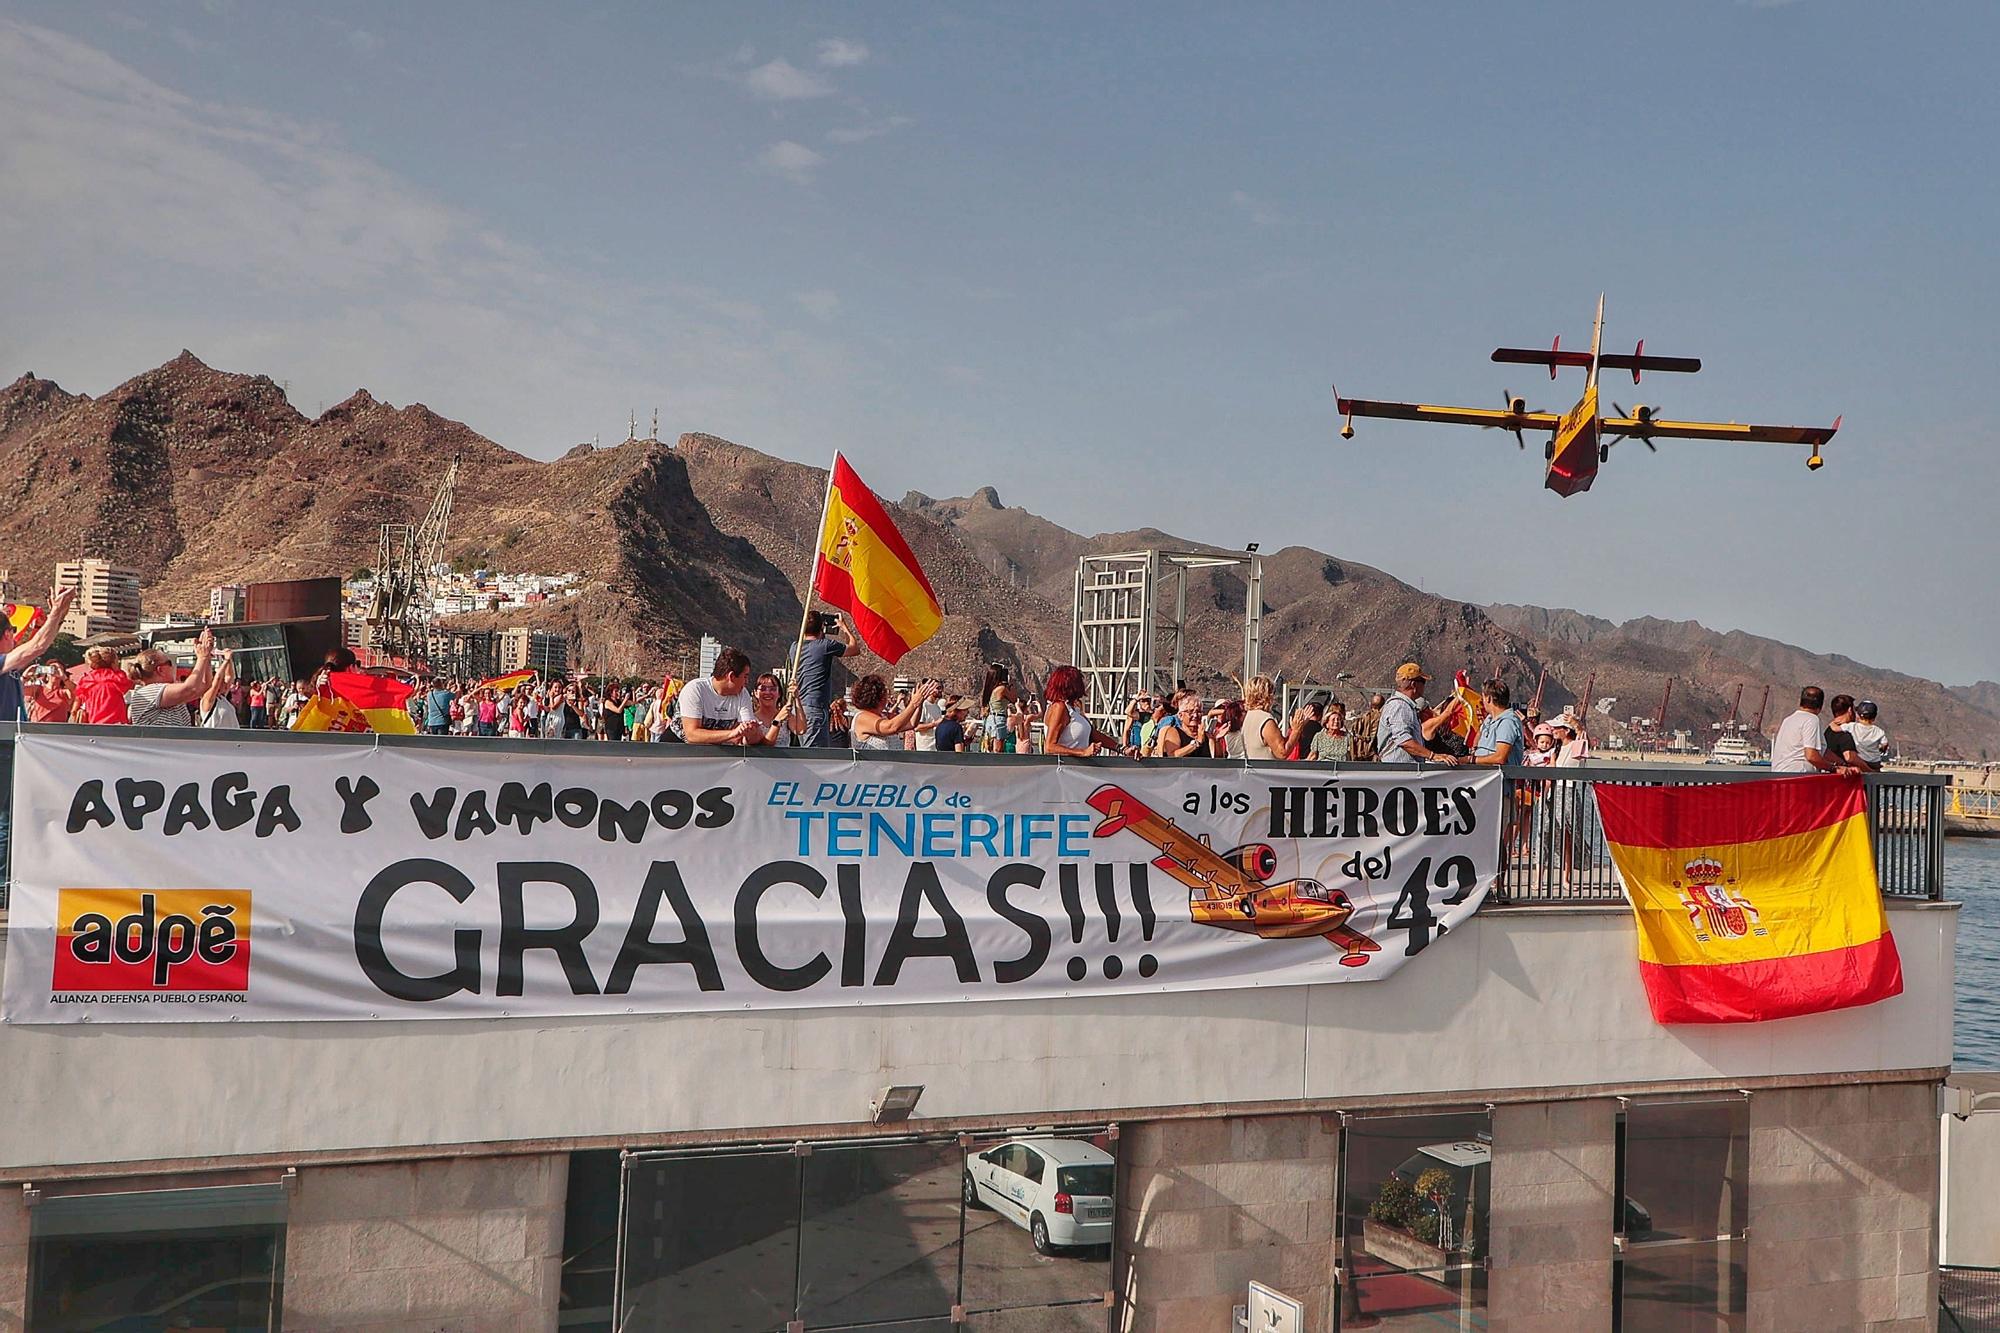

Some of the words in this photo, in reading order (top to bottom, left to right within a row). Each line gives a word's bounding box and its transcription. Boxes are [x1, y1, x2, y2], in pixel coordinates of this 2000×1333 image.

[65, 771, 302, 838] APAGA
[334, 775, 381, 834] Y
[409, 781, 735, 844] VAMONOS
[767, 781, 804, 807] EL
[812, 783, 938, 809] PUEBLO
[944, 792, 972, 808] de
[1182, 792, 1201, 816] a
[1209, 785, 1251, 815] los
[1266, 779, 1477, 838] HÉROES
[784, 810, 1092, 858] TENERIFE
[1341, 845, 1392, 882] del
[353, 858, 1159, 1003] GRACIAS!!!
[50, 994, 98, 1004] ALIANZA
[101, 994, 150, 1004] DEFENSA
[153, 994, 196, 1003] PUEBLO
[198, 992, 248, 1003] ESPAÑOL
